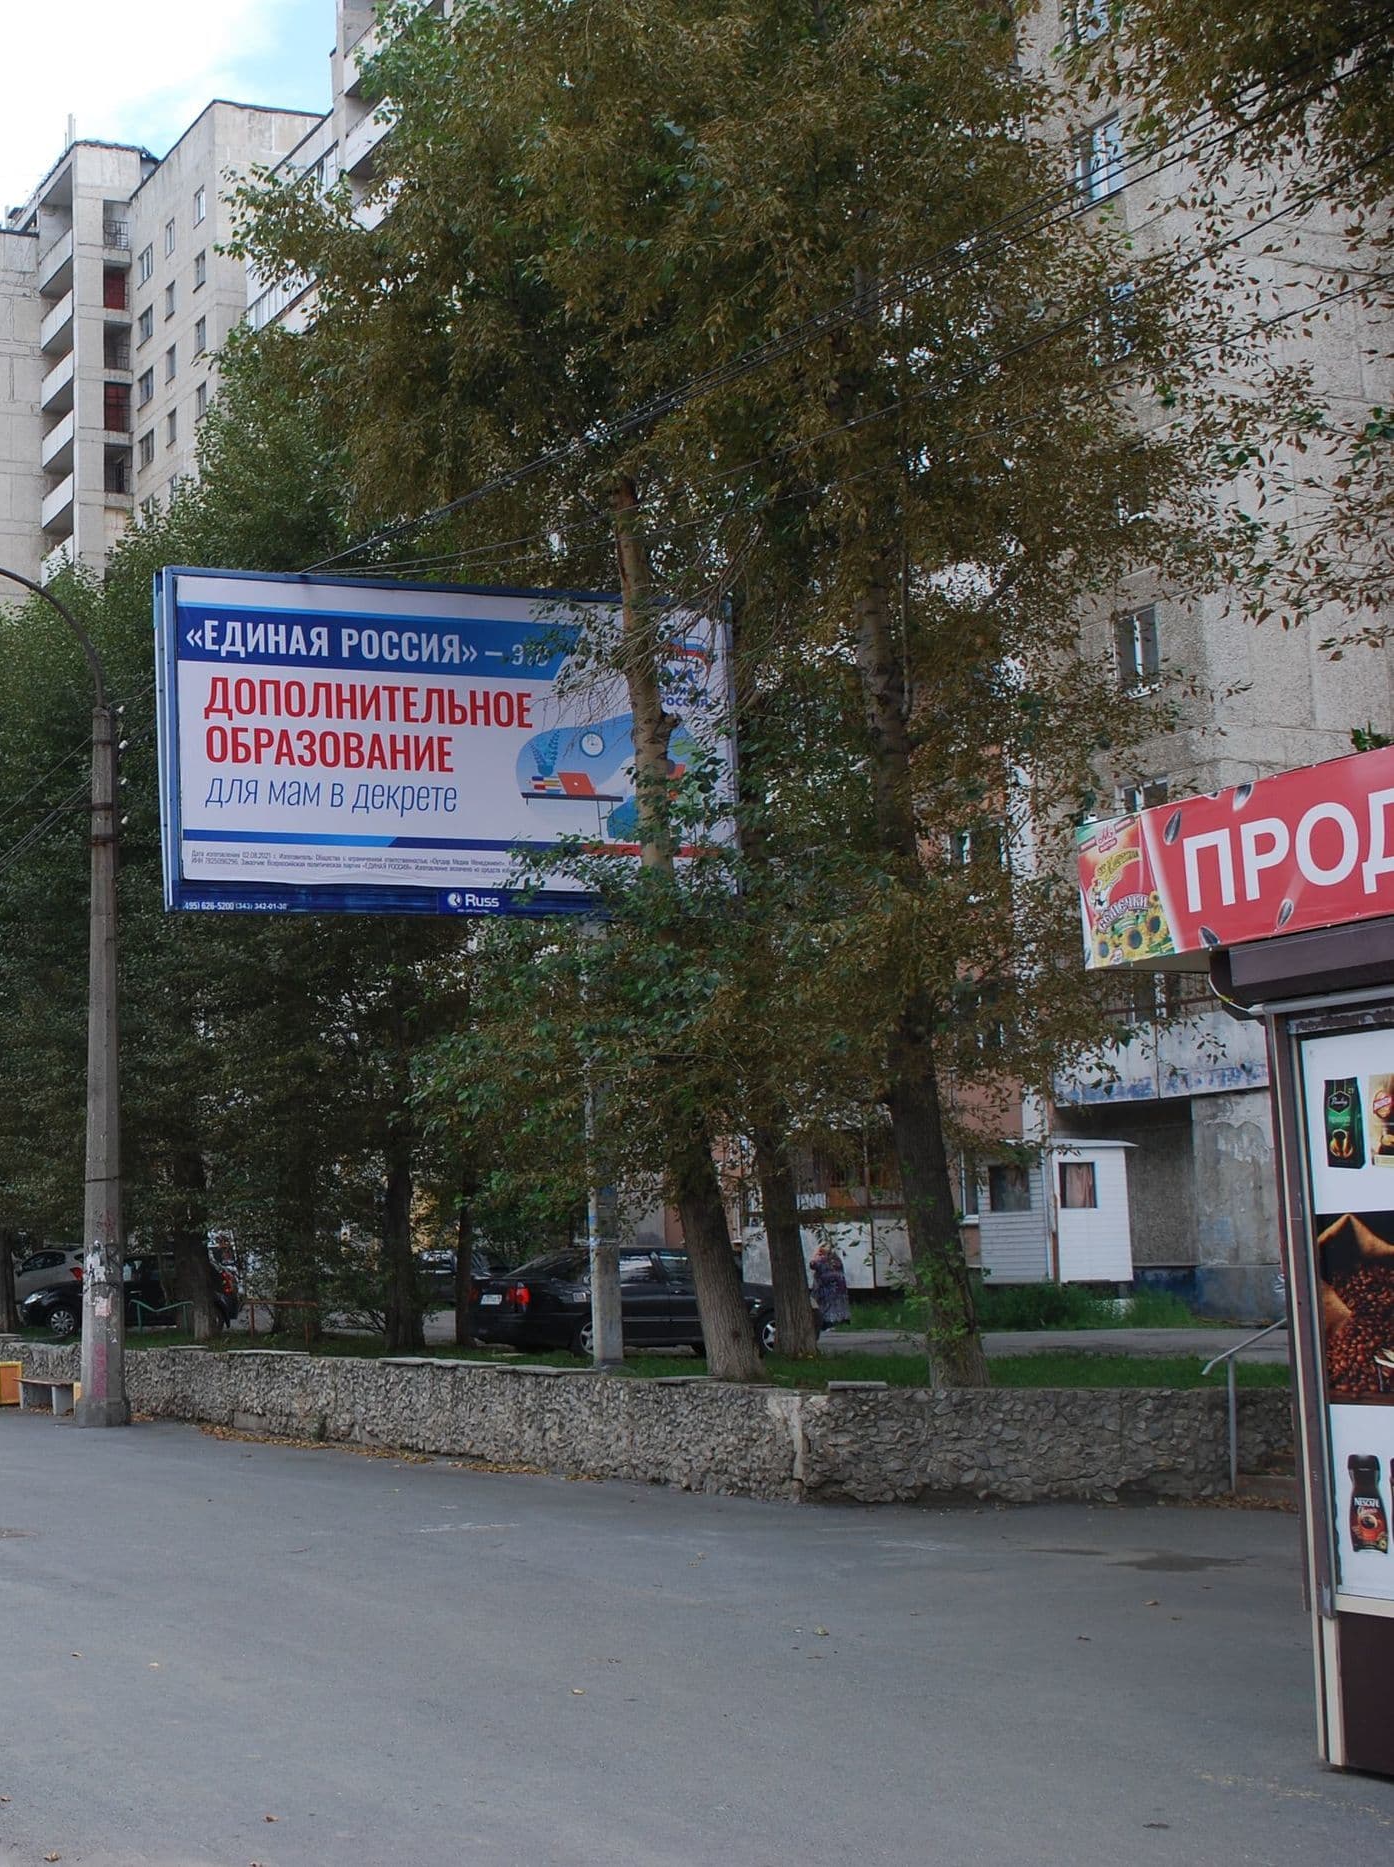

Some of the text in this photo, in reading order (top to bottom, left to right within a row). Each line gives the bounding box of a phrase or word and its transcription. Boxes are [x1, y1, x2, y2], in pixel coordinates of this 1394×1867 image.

[186, 620, 329, 658] «ЕДИНАЯ
[341, 628, 478, 664] РОССИЯ»
[204, 676, 533, 728] ДОПОЛНИТЕЛЬНОЕ
[206, 725, 454, 772] ОБРАЗОВАНИЕ
[205, 777, 457, 817] для мам в декрете
[465, 893, 499, 907] Russ
